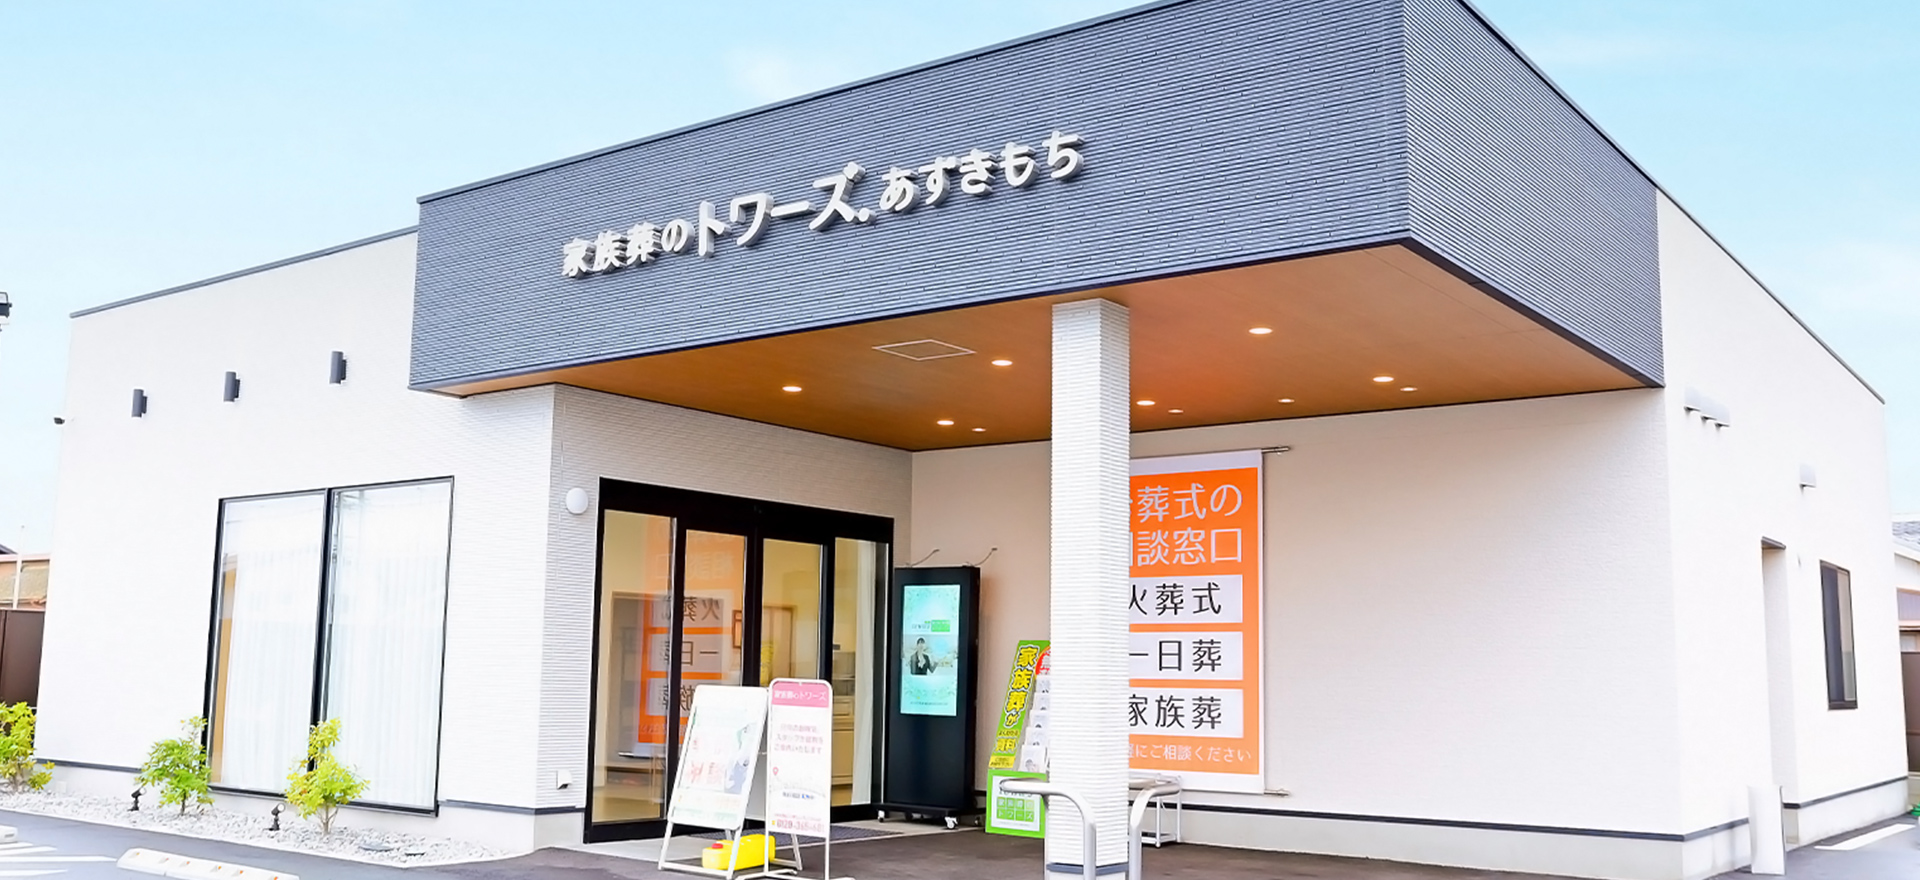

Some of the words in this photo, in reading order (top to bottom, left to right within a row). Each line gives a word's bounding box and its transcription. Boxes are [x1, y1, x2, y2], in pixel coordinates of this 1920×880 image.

[1130, 483, 1243, 523] 葬式の
[1130, 527, 1242, 567] 談窓口
[1129, 581, 1222, 617] 火葬式
[1129, 639, 1222, 673] 一日葬
[1129, 694, 1222, 731] 家族葬
